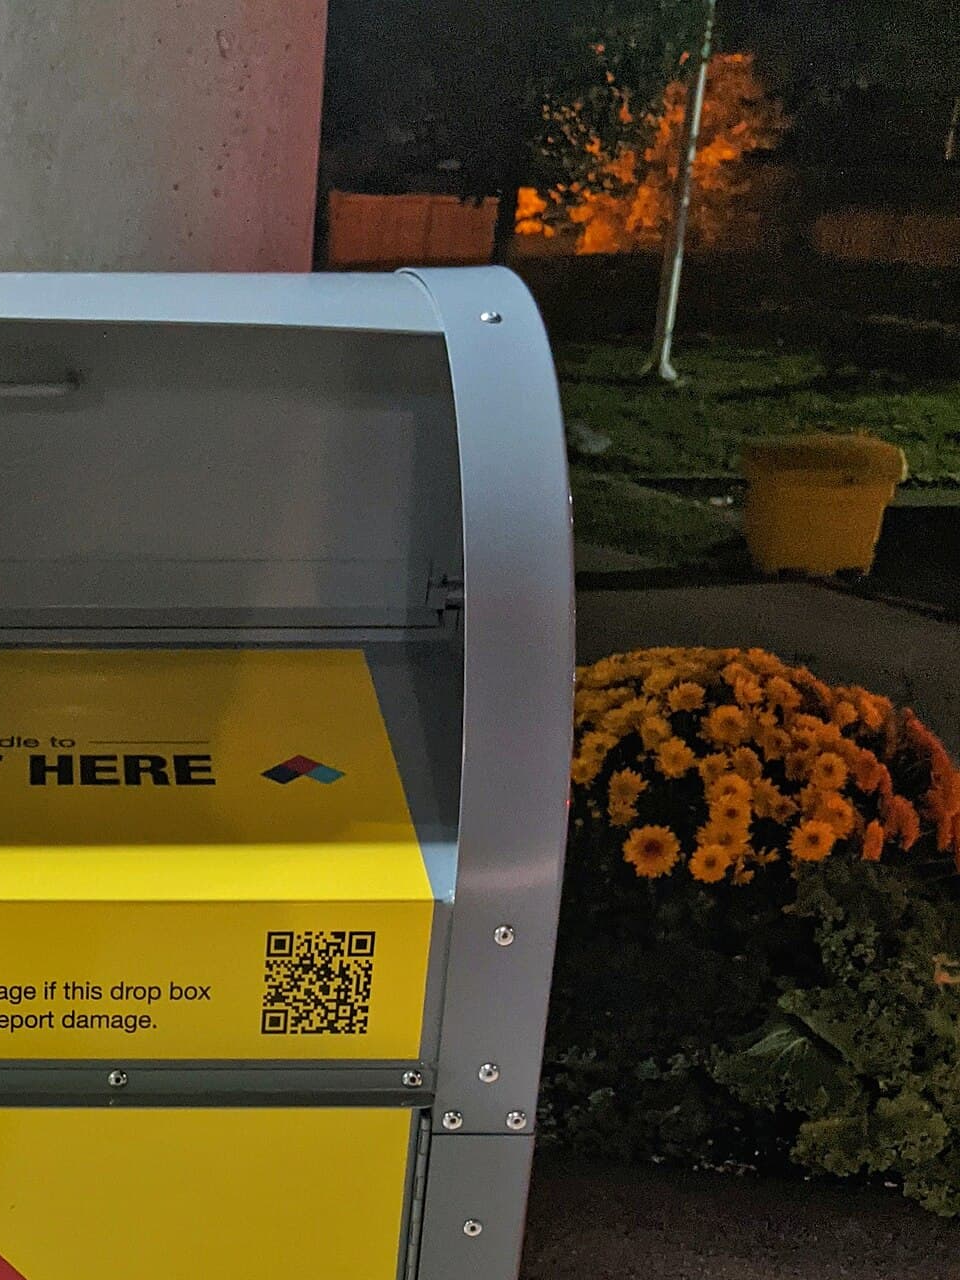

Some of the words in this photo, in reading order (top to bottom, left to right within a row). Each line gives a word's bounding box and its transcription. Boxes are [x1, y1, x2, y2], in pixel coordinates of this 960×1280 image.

[49, 735, 76, 749] to
[28, 753, 217, 786] HERE
[43, 980, 58, 1001] if
[62, 980, 103, 1001] this
[109, 980, 162, 1006] drop
[169, 981, 212, 1002] box
[61, 1010, 157, 1035] damage.
